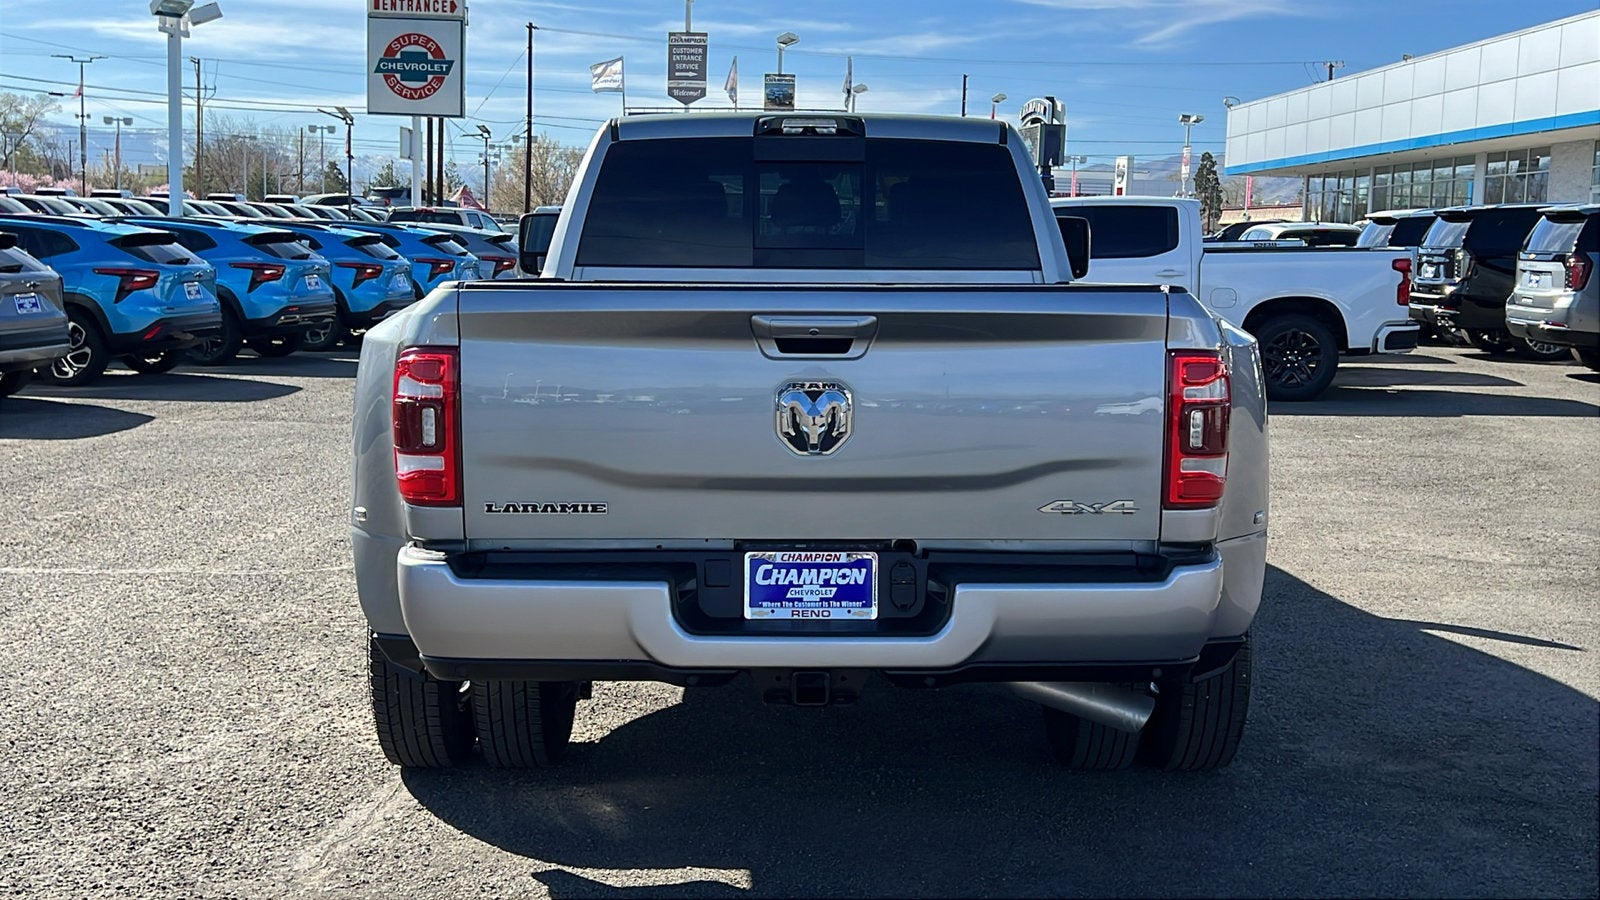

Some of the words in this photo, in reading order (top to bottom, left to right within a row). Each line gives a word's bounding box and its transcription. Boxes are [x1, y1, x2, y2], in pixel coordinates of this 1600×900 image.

[382, 0, 448, 13] ENTRANCE
[391, 35, 437, 51] SUPER
[379, 61, 449, 72] CHEVROLET
[387, 77, 441, 99] SERVICE
[484, 502, 607, 515] LARAMIE
[781, 553, 842, 562] CHAMPION
[755, 564, 867, 585] CHAMPION
[791, 609, 831, 618] RENO
